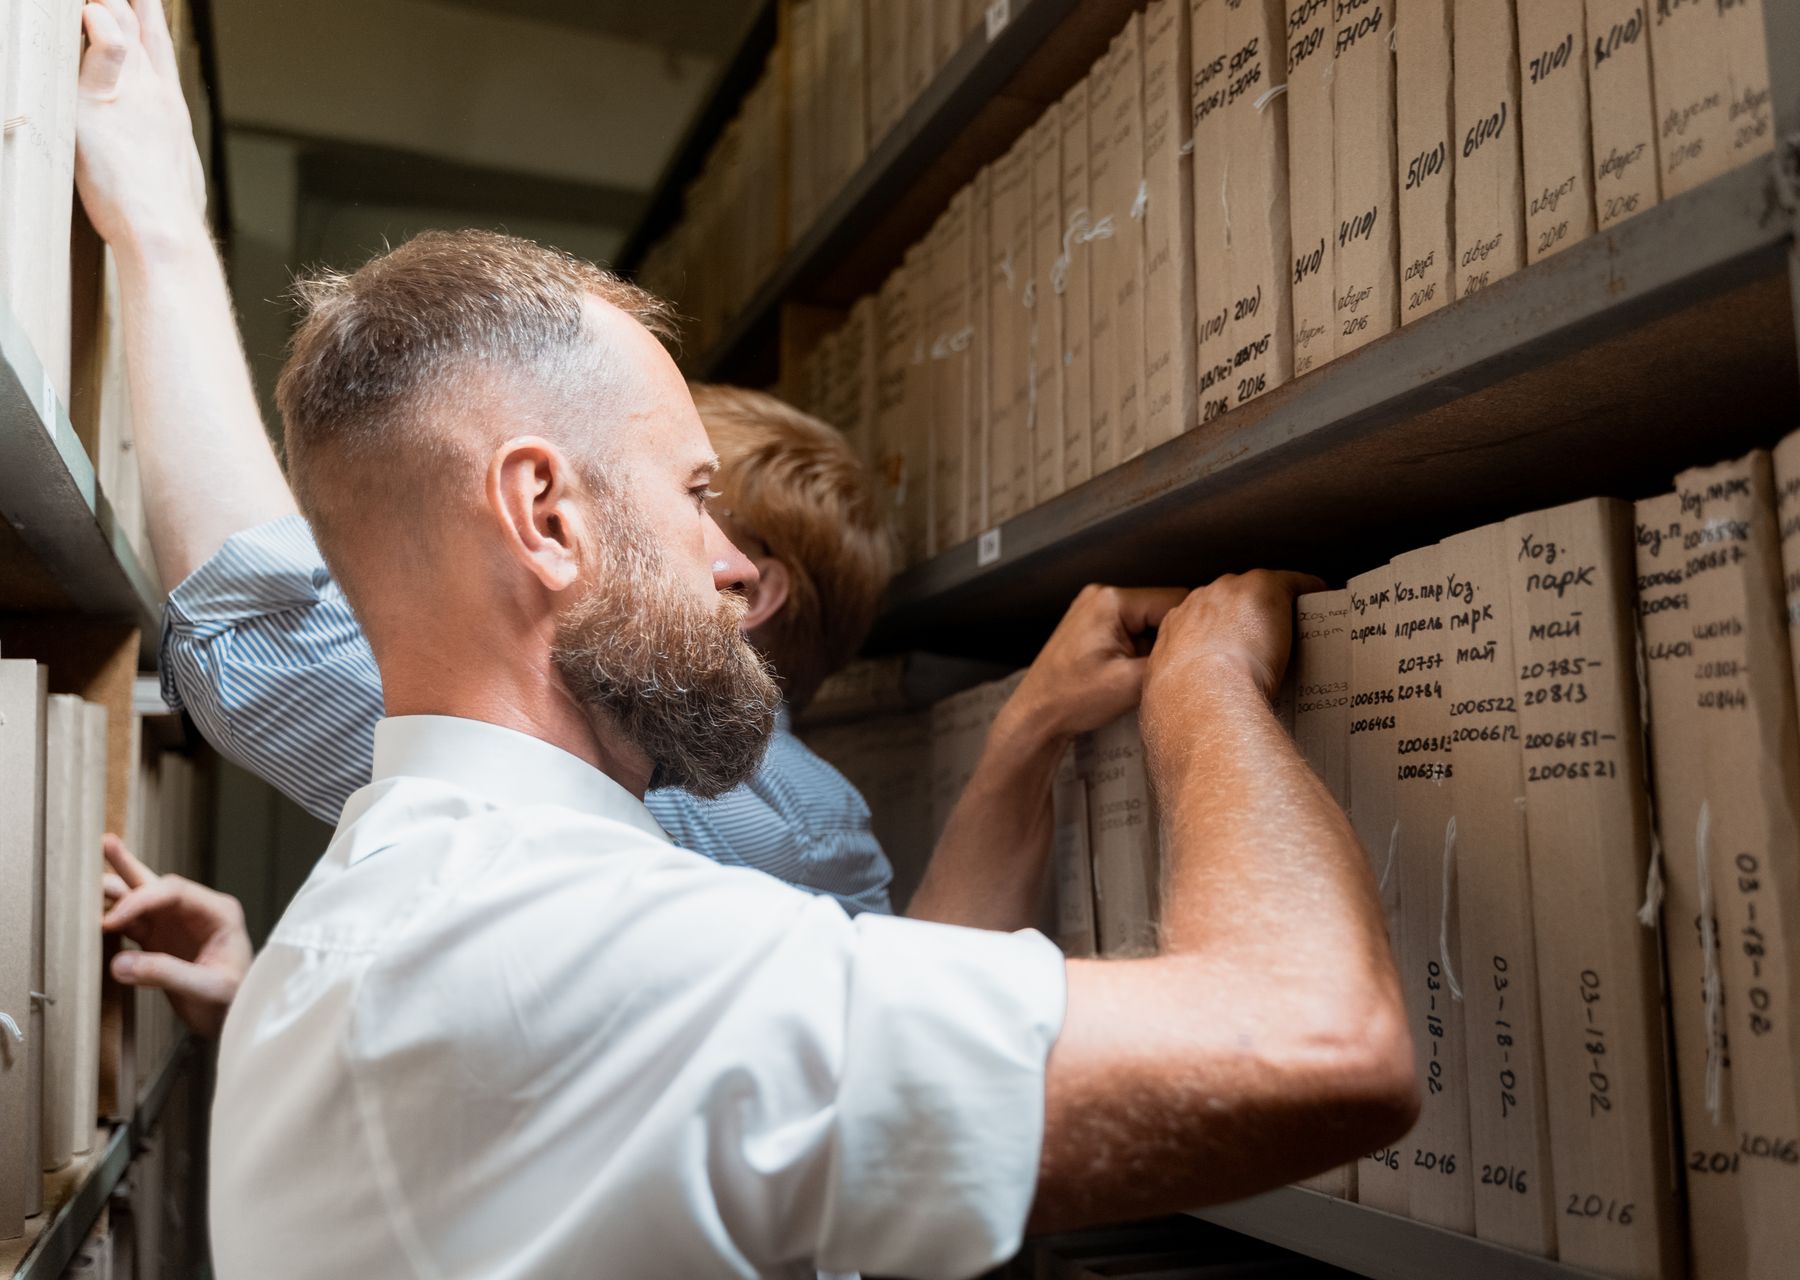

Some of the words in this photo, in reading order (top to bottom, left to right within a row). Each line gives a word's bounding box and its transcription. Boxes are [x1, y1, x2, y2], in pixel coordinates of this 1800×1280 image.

[1530, 33, 1572, 85] 7(10)
[1462, 102, 1507, 158] 6(10)
[1406, 142, 1445, 190] 5(10)
[1339, 206, 1377, 248] 4(10)
[1294, 238, 1325, 285] 3(10)
[1237, 372, 1266, 403] 2016
[1526, 565, 1596, 599] парк
[1528, 610, 1584, 641] май
[1456, 640, 1498, 665] май
[1398, 680, 1443, 701] 20784
[1524, 682, 1588, 707] 20813
[1449, 697, 1517, 717] 2006522
[1452, 724, 1521, 743] 2006612
[1528, 760, 1617, 782] 2006521
[1414, 1148, 1457, 1175] 2016
[1481, 1165, 1528, 1194] 2016
[1565, 1194, 1636, 1226] 2016
